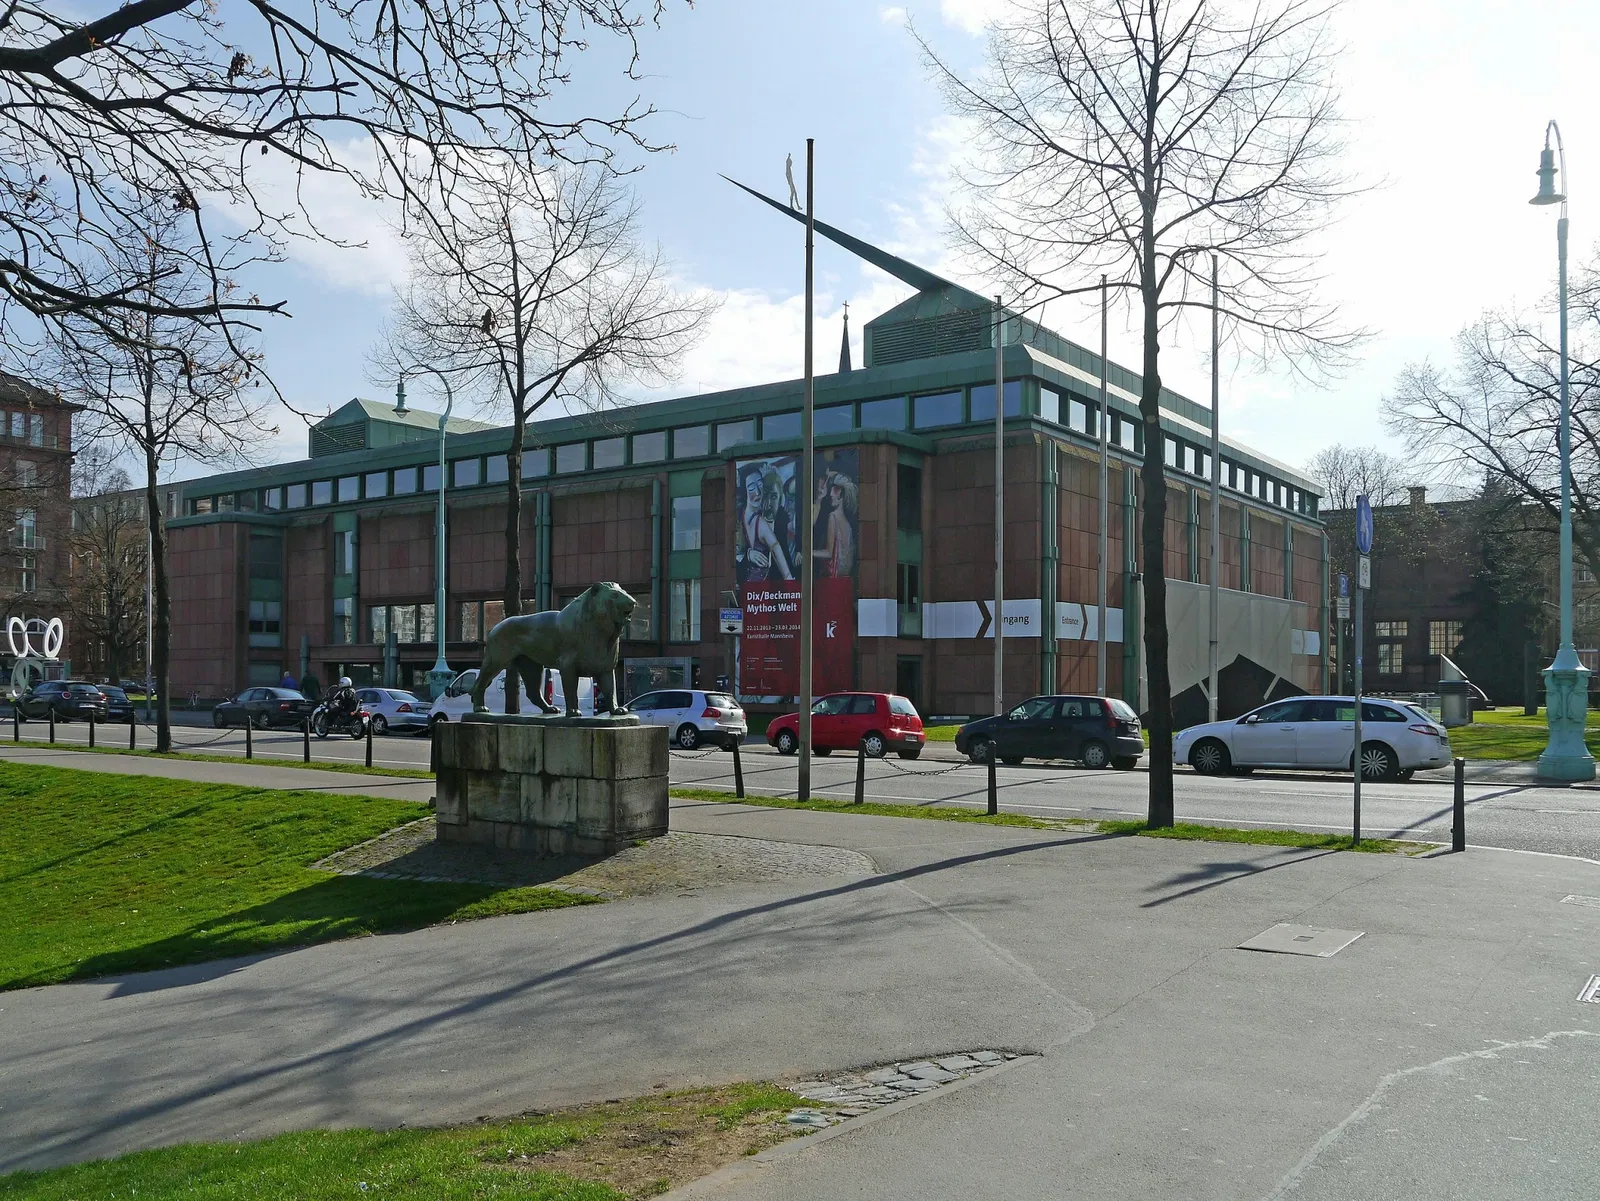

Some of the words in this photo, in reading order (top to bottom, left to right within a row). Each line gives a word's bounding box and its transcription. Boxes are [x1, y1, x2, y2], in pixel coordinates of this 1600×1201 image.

[746, 591, 802, 602] Dix/Beckman
[746, 604, 776, 614] Mythos
[778, 603, 797, 612] Welt
[1002, 616, 1030, 625] ngang
[1062, 616, 1079, 625] Entrance
